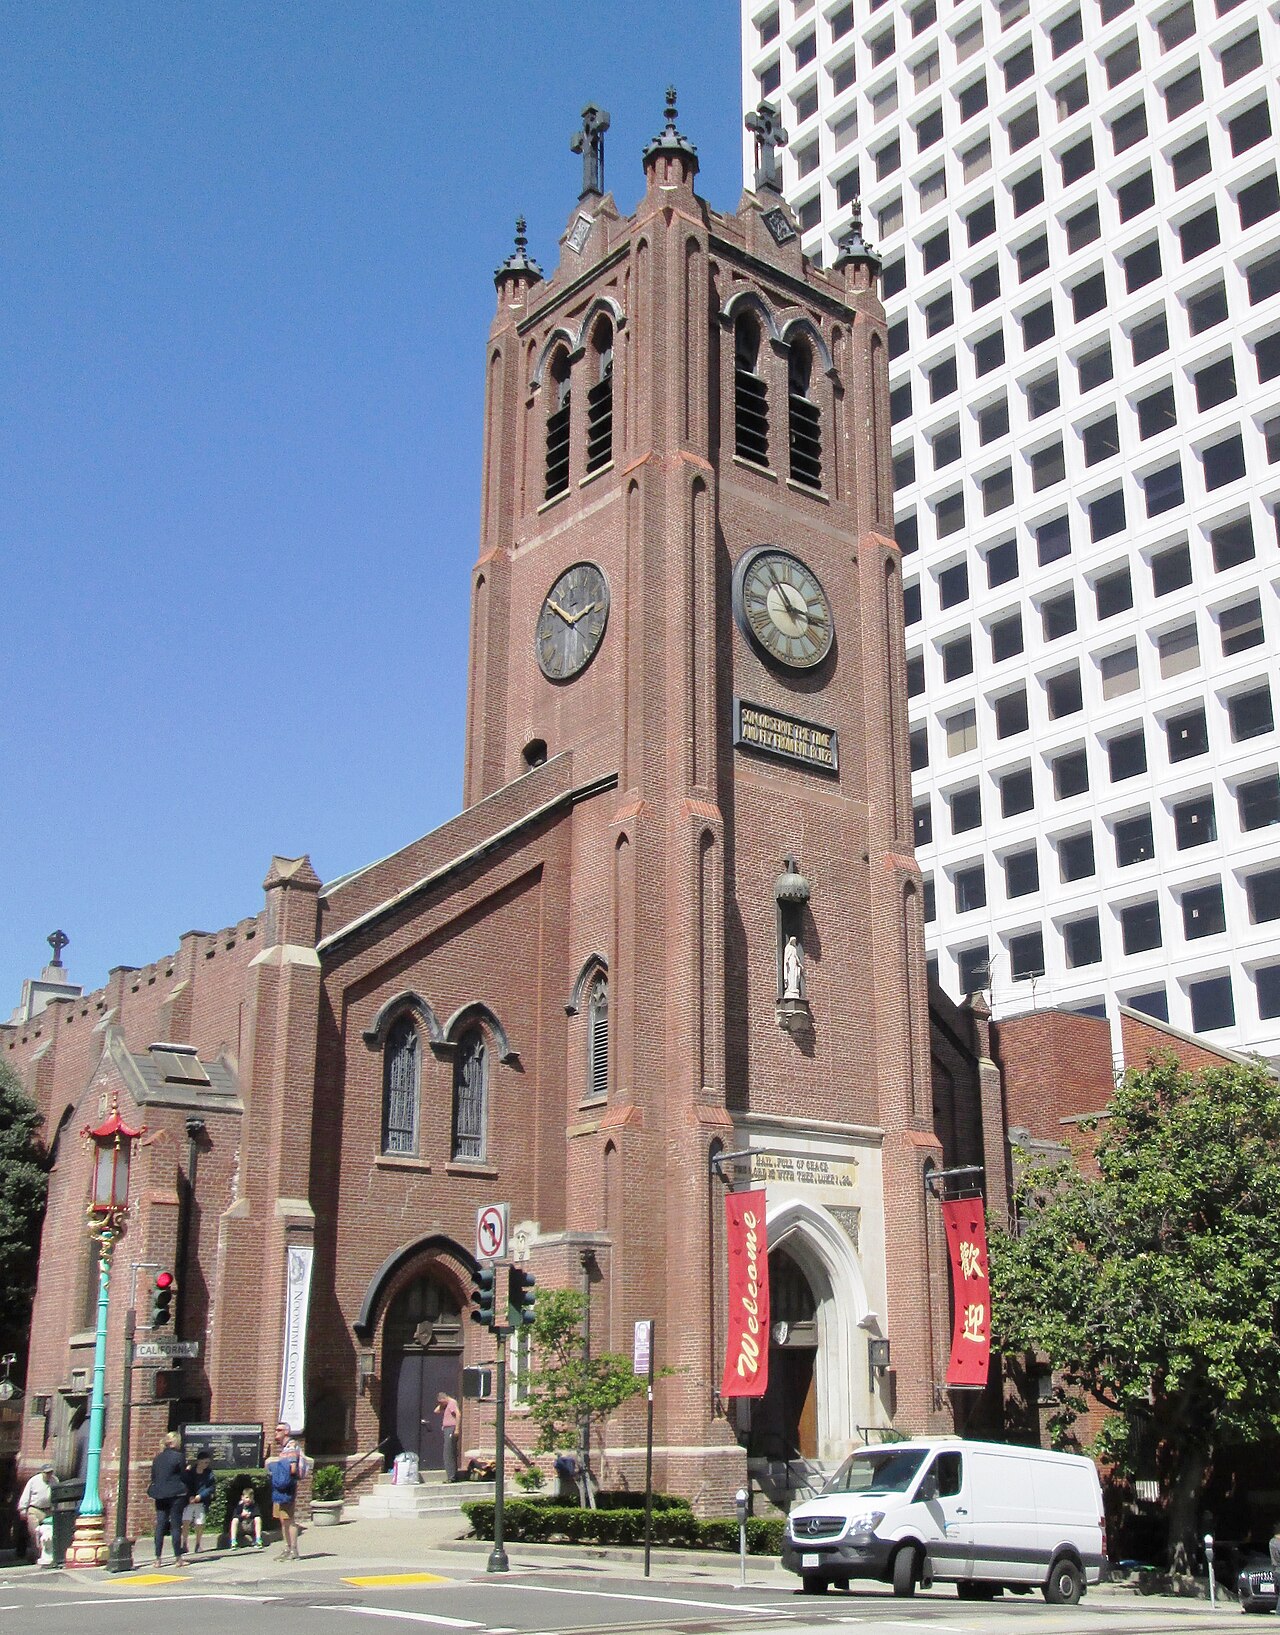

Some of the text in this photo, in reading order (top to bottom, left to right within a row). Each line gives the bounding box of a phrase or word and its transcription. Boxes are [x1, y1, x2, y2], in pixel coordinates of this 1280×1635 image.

[742, 724, 759, 741] AND
[759, 729, 773, 745] FLY
[774, 734, 794, 752] FROM
[795, 739, 809, 757] EVIL
[759, 714, 793, 737] OBSERVE
[794, 725, 810, 742] THE
[811, 730, 830, 748] TIME
[776, 1170, 794, 1182] WITH
[737, 1210, 760, 1377] Welcome
